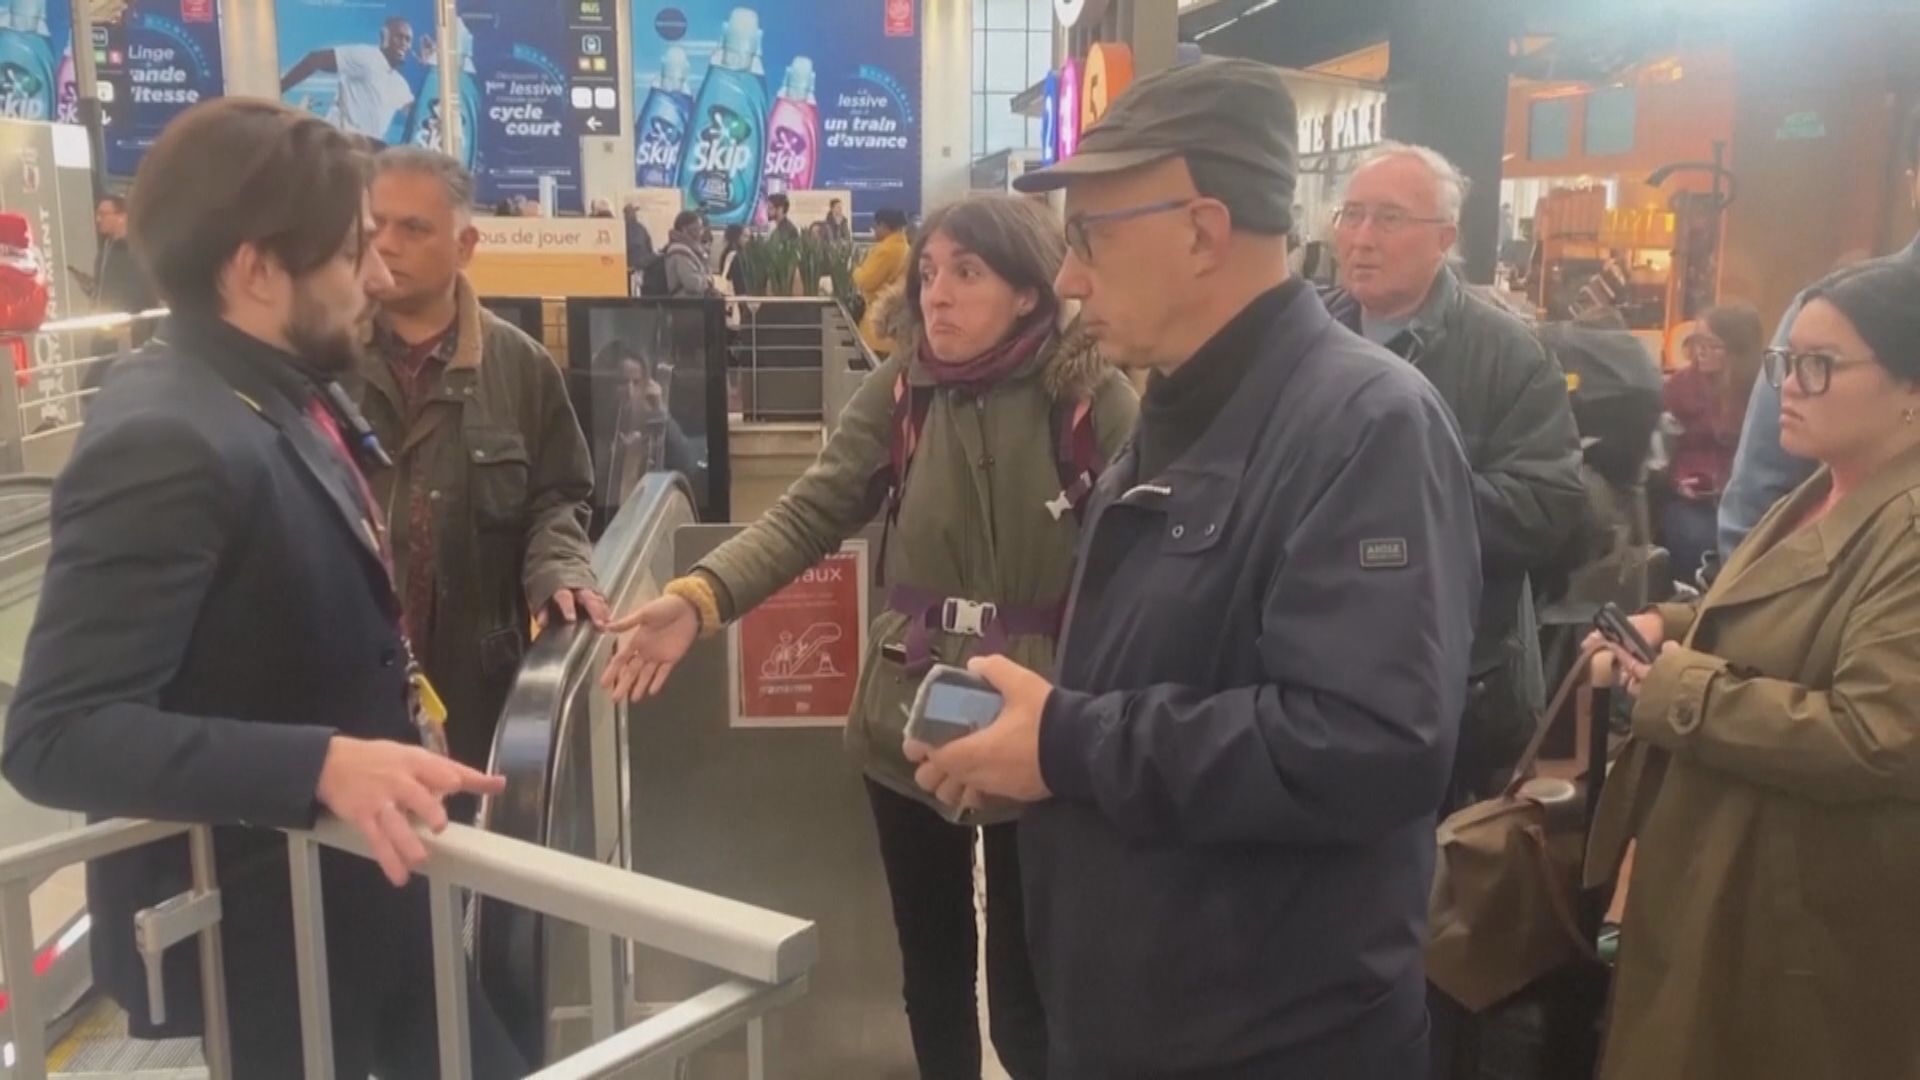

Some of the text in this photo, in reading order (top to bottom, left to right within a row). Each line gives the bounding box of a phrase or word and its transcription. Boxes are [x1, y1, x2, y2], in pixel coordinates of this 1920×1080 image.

[128, 45, 174, 62] Linge
[130, 67, 187, 83] ande
[131, 85, 200, 104] itesse
[509, 80, 563, 96] lessive
[838, 93, 888, 108] lessive
[489, 104, 543, 122] cycle
[505, 120, 562, 137] court
[824, 116, 896, 133] un train
[478, 228, 582, 248] ous de jouer
[794, 567, 842, 584] aux
